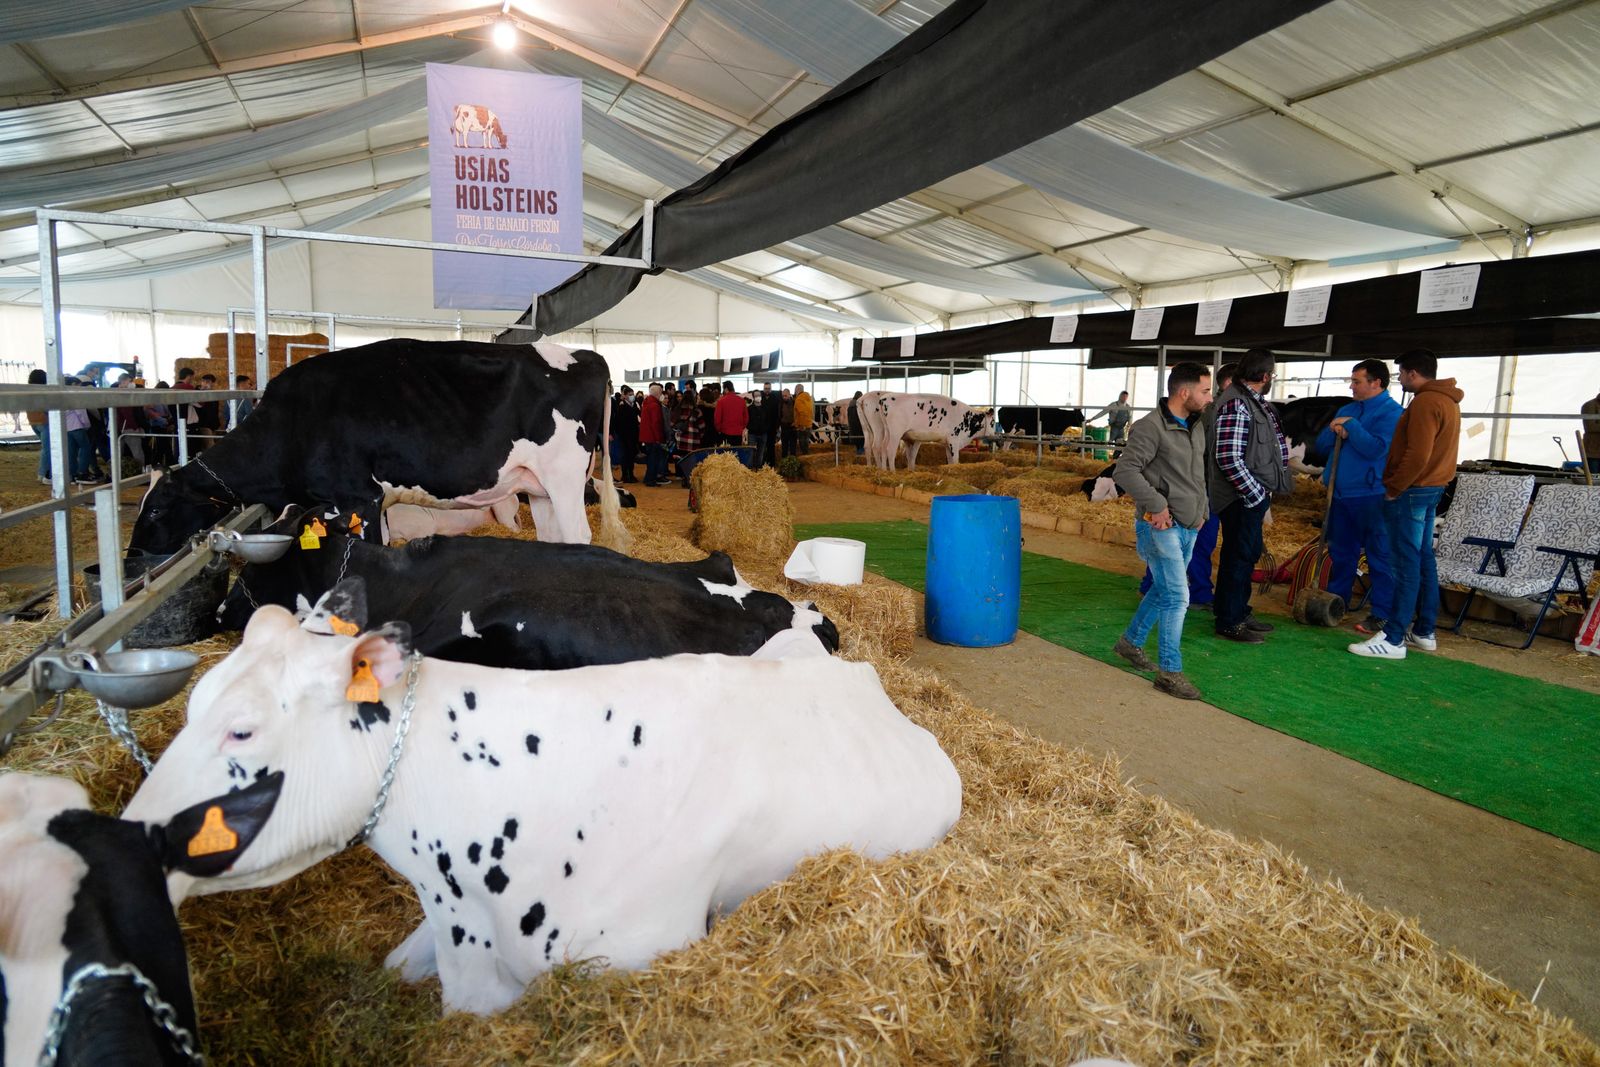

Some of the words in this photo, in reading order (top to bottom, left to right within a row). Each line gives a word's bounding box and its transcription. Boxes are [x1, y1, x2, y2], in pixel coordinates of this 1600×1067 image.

[456, 184, 558, 215] HOLSTEINS
[456, 214, 481, 230] FERIA
[484, 216, 495, 231] DE
[496, 217, 529, 232] GANADO
[531, 218, 560, 234] FRISÓN
